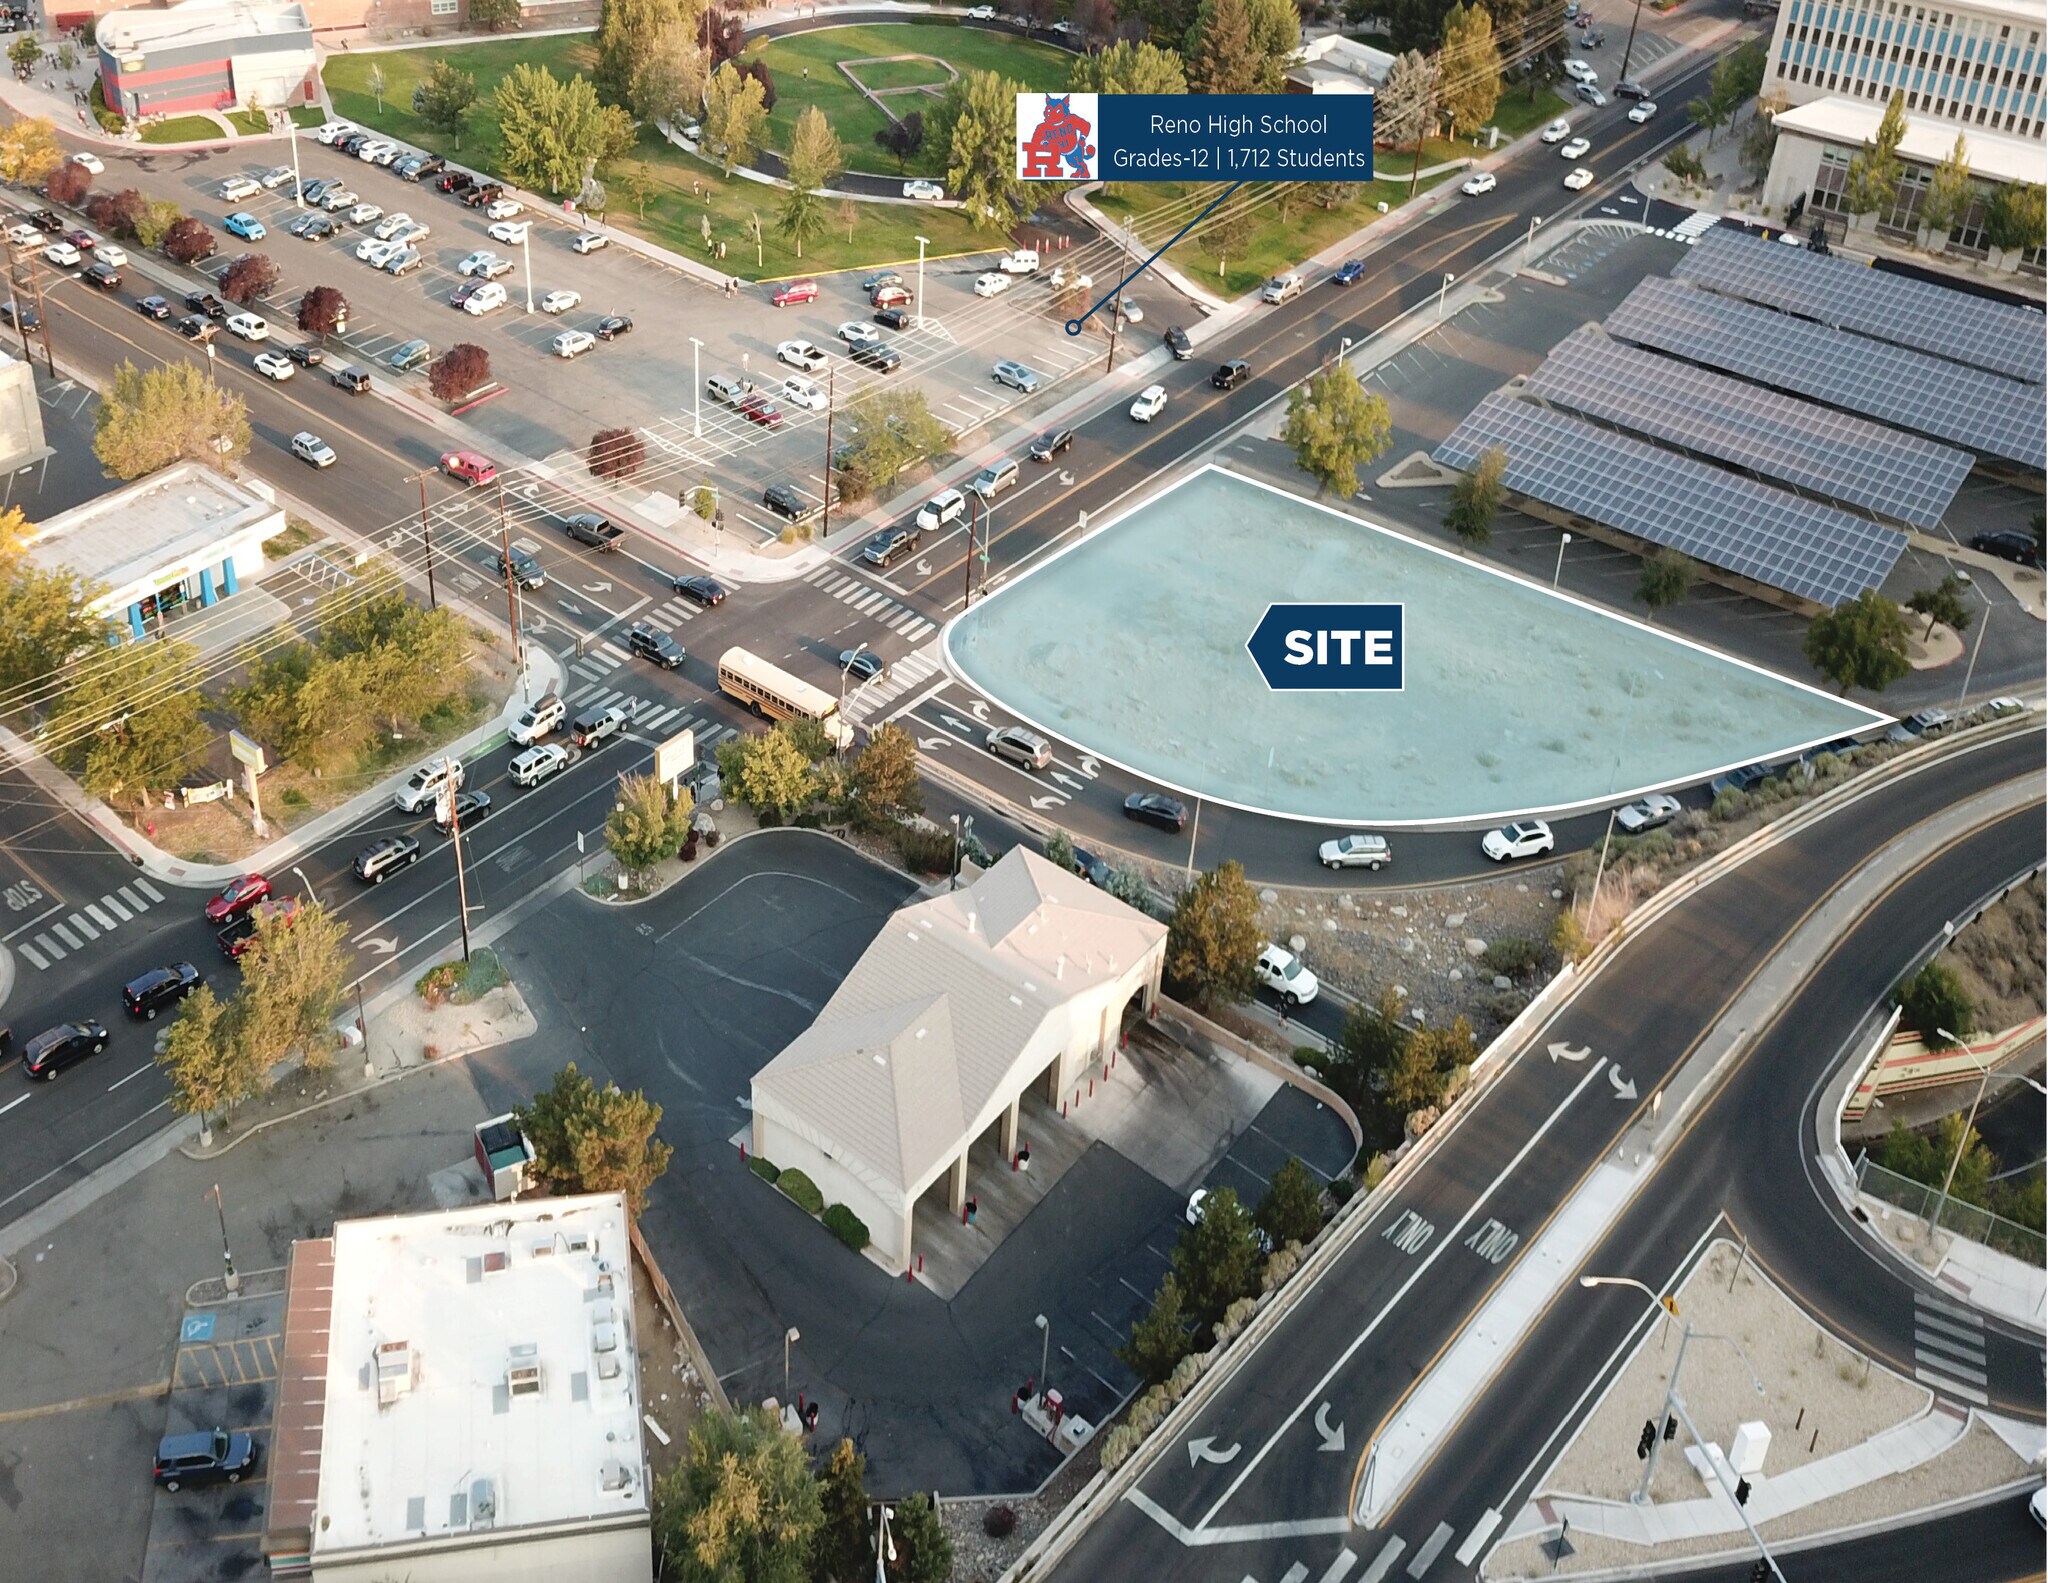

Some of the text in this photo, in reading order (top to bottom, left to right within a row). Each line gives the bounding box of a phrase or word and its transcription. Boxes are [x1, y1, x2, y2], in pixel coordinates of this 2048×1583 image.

[2, 880, 43, 912] STOP
[1381, 1208, 1435, 1255] ONLY
[1464, 1217, 1519, 1264] ONLY
